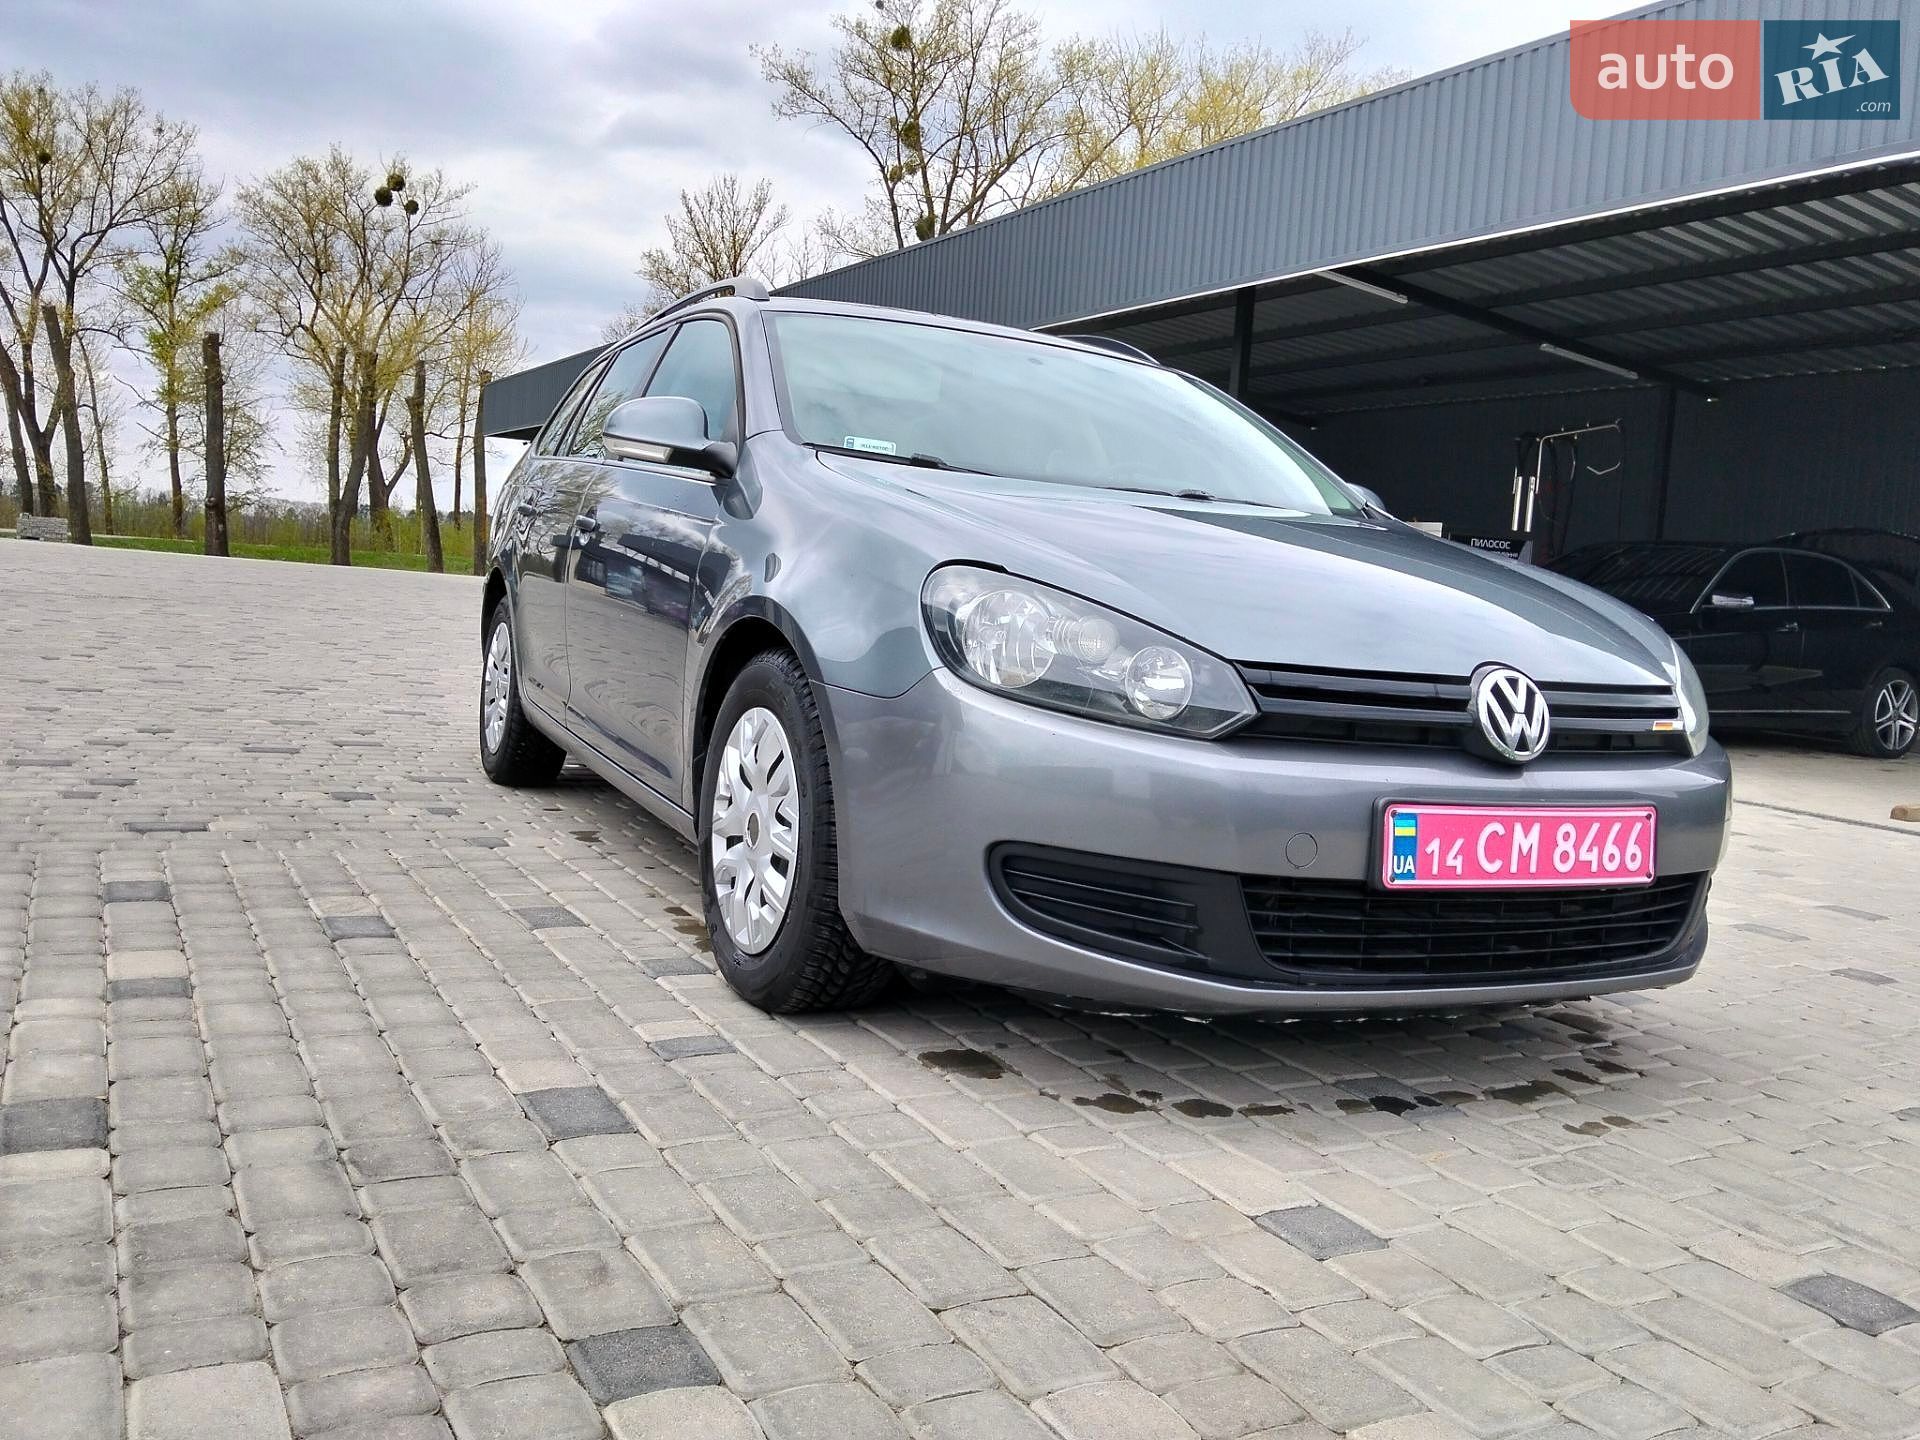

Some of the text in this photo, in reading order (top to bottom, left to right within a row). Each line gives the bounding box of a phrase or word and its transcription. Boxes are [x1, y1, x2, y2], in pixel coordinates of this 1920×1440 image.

[1471, 538, 1511, 549] ПИЛОСОС
[1425, 822, 1643, 875] 14 CM 8466
[1393, 855, 1416, 874] UA
